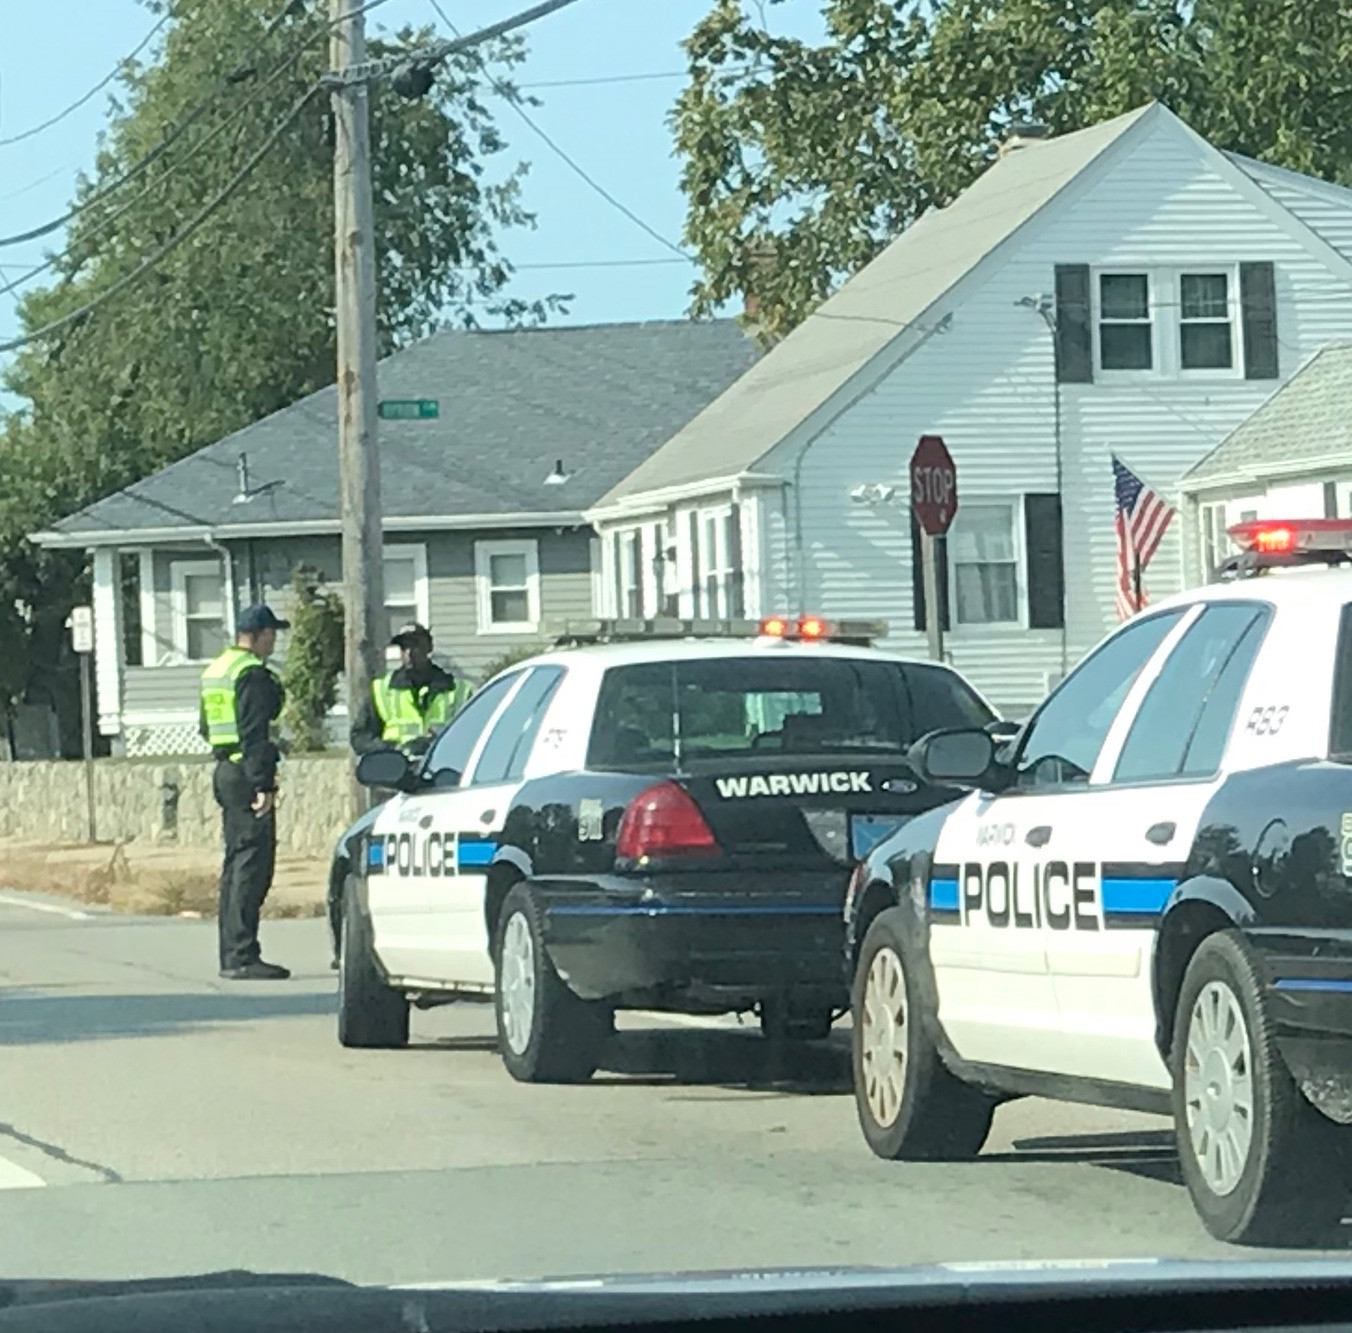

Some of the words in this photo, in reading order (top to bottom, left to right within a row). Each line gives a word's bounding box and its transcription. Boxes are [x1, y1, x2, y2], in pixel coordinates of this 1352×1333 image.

[914, 467, 953, 504] STOP
[715, 771, 873, 799] WARWICK
[386, 831, 456, 877] POLICE
[964, 860, 1100, 932] POLICE
